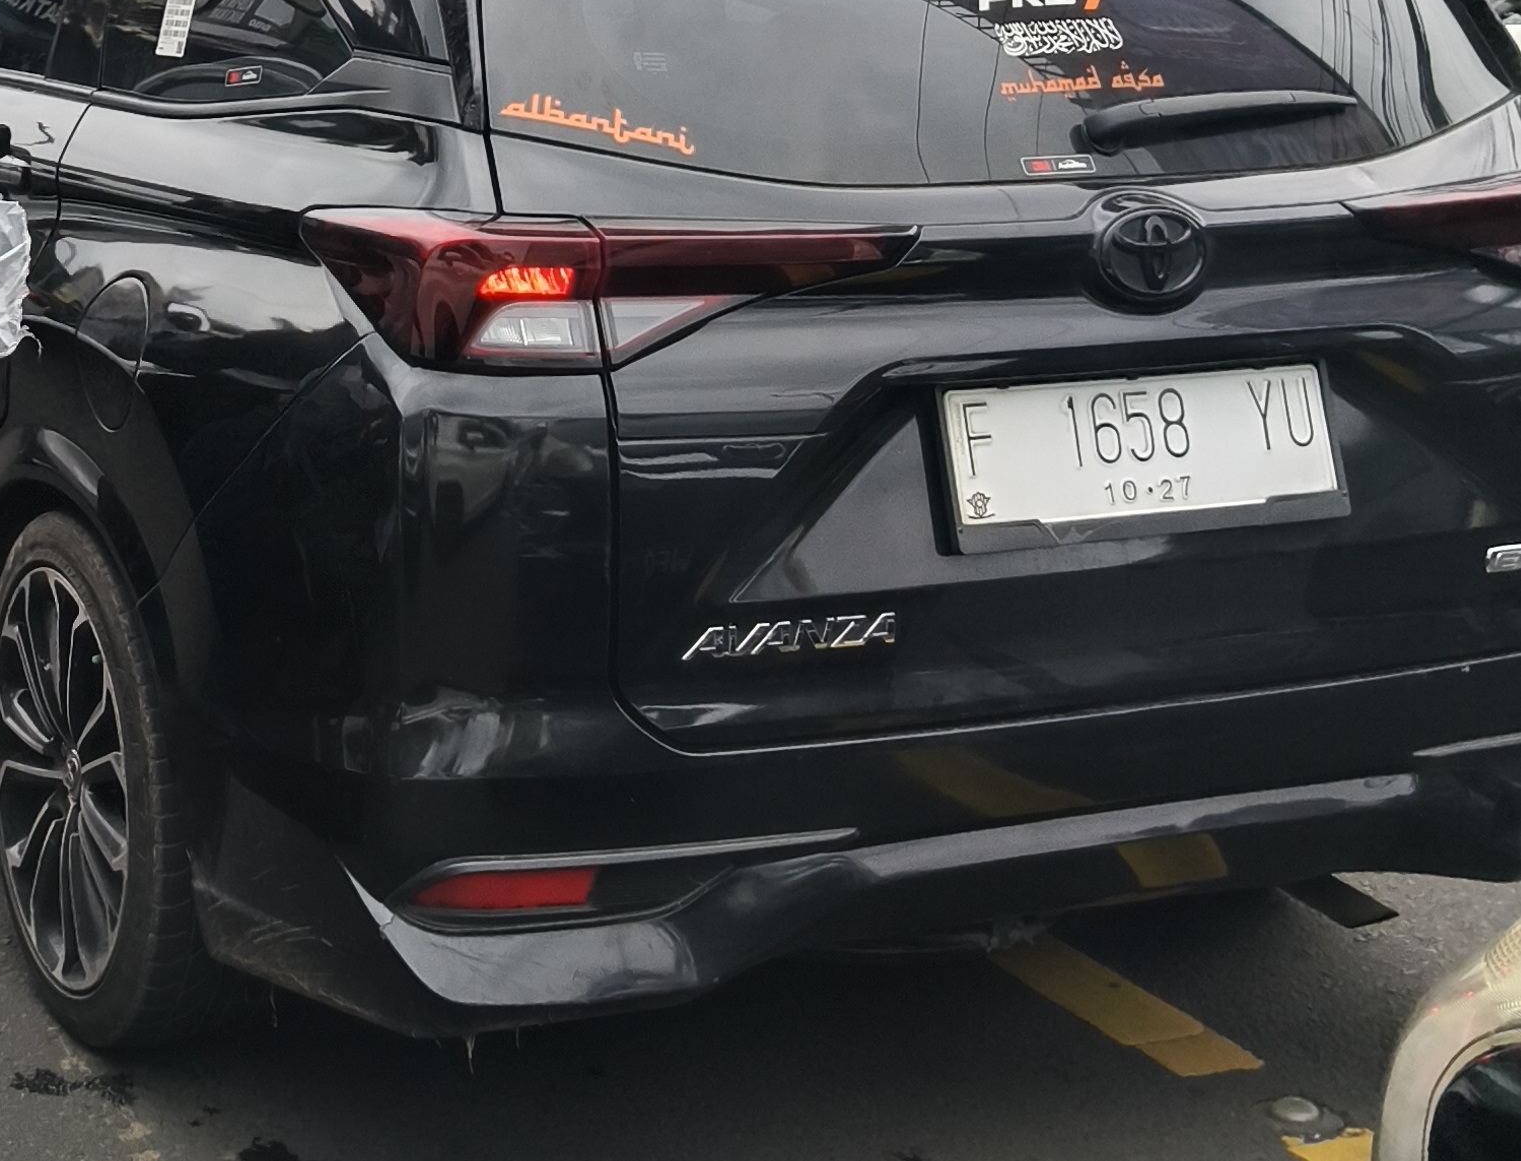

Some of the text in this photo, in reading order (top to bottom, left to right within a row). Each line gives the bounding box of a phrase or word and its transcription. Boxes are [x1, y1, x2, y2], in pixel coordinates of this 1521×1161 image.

[500, 93, 695, 155] albantani
[962, 400, 992, 477] F
[1065, 387, 1190, 468] 1658
[1246, 376, 1314, 451] YU
[682, 612, 896, 660] AVANZA
